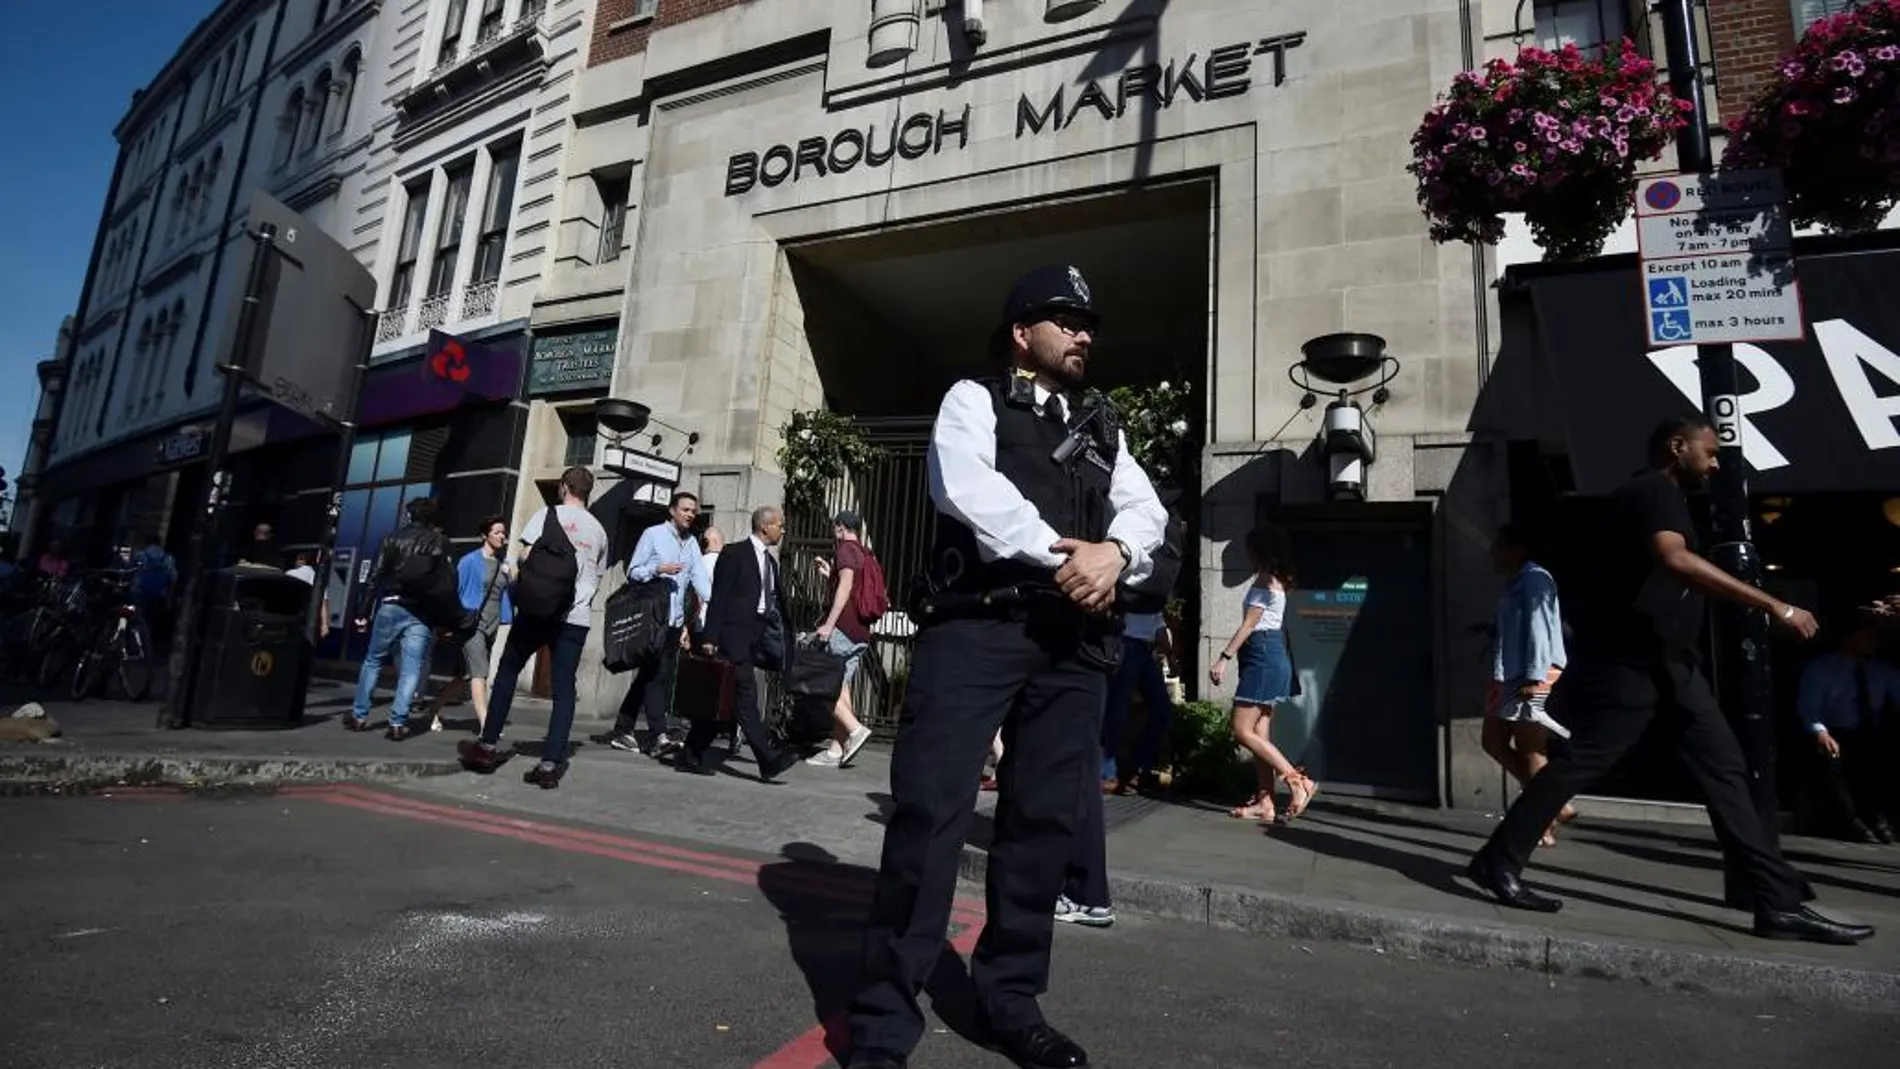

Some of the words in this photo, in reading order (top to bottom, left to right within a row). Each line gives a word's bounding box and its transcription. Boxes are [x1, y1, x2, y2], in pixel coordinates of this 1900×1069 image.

[723, 103, 970, 196] BOROUGH
[1015, 31, 1307, 139] MARKET
[1686, 185, 1717, 197] RED
[1669, 217, 1689, 227] No
[1675, 229, 1692, 238] on
[1677, 242, 1685, 250] 7
[1688, 242, 1709, 250] am
[1720, 239, 1727, 247] 7
[1730, 238, 1754, 248] pm
[1648, 262, 1695, 274] Except
[1702, 259, 1717, 269] 10
[1721, 259, 1742, 268] am
[1691, 277, 1747, 289] Loading
[1692, 291, 1722, 302] max
[1726, 289, 1746, 300] 20
[1749, 287, 1783, 299] mins
[1695, 318, 1724, 329] max
[1730, 317, 1739, 327] 3
[1744, 316, 1785, 327] hours
